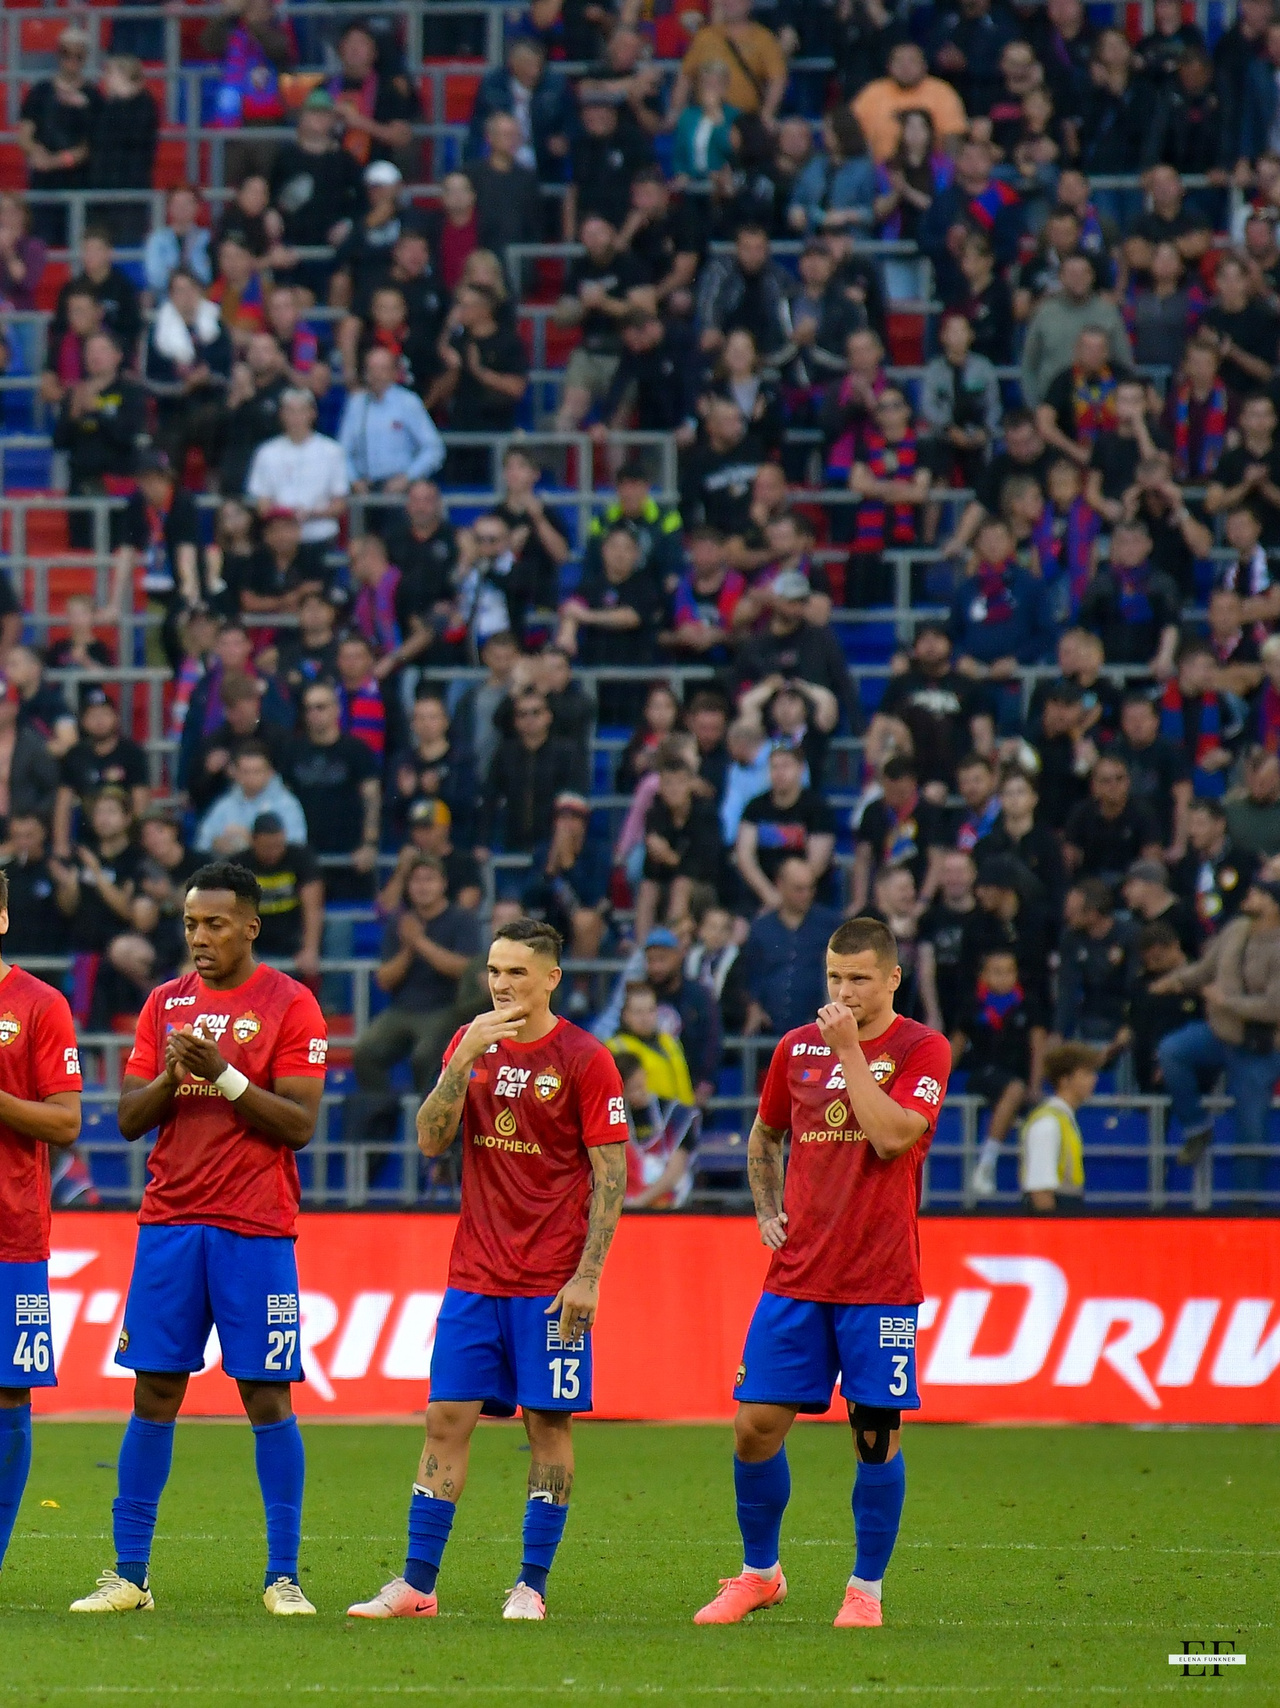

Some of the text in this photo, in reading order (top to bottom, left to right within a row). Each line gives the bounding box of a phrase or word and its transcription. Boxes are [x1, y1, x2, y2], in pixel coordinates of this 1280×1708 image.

[194, 1014, 230, 1028] FON
[64, 1048, 78, 1062] FO
[308, 1050, 326, 1064] BE
[807, 1046, 832, 1056] ПСБ
[66, 1060, 80, 1075] BE
[496, 1066, 532, 1084] FON
[494, 1080, 527, 1098] BET
[825, 1076, 847, 1090] BE
[917, 1076, 942, 1096] FON
[913, 1086, 940, 1106] BET
[608, 1096, 624, 1112] FO
[609, 1110, 627, 1125] BE
[474, 1134, 542, 1155] APOTHEKA
[800, 1130, 868, 1144] APOTHEKA
[16, 1294, 48, 1308] ВЭБ
[267, 1294, 297, 1308] ВЭБ
[16, 1312, 49, 1326] РФ
[268, 1311, 297, 1326] РФ
[880, 1316, 915, 1332] ВЭБ
[880, 1335, 915, 1349] РФ
[13, 1332, 49, 1372] 46
[264, 1330, 296, 1370] 27
[548, 1358, 580, 1400] 13
[889, 1355, 908, 1396] 3
